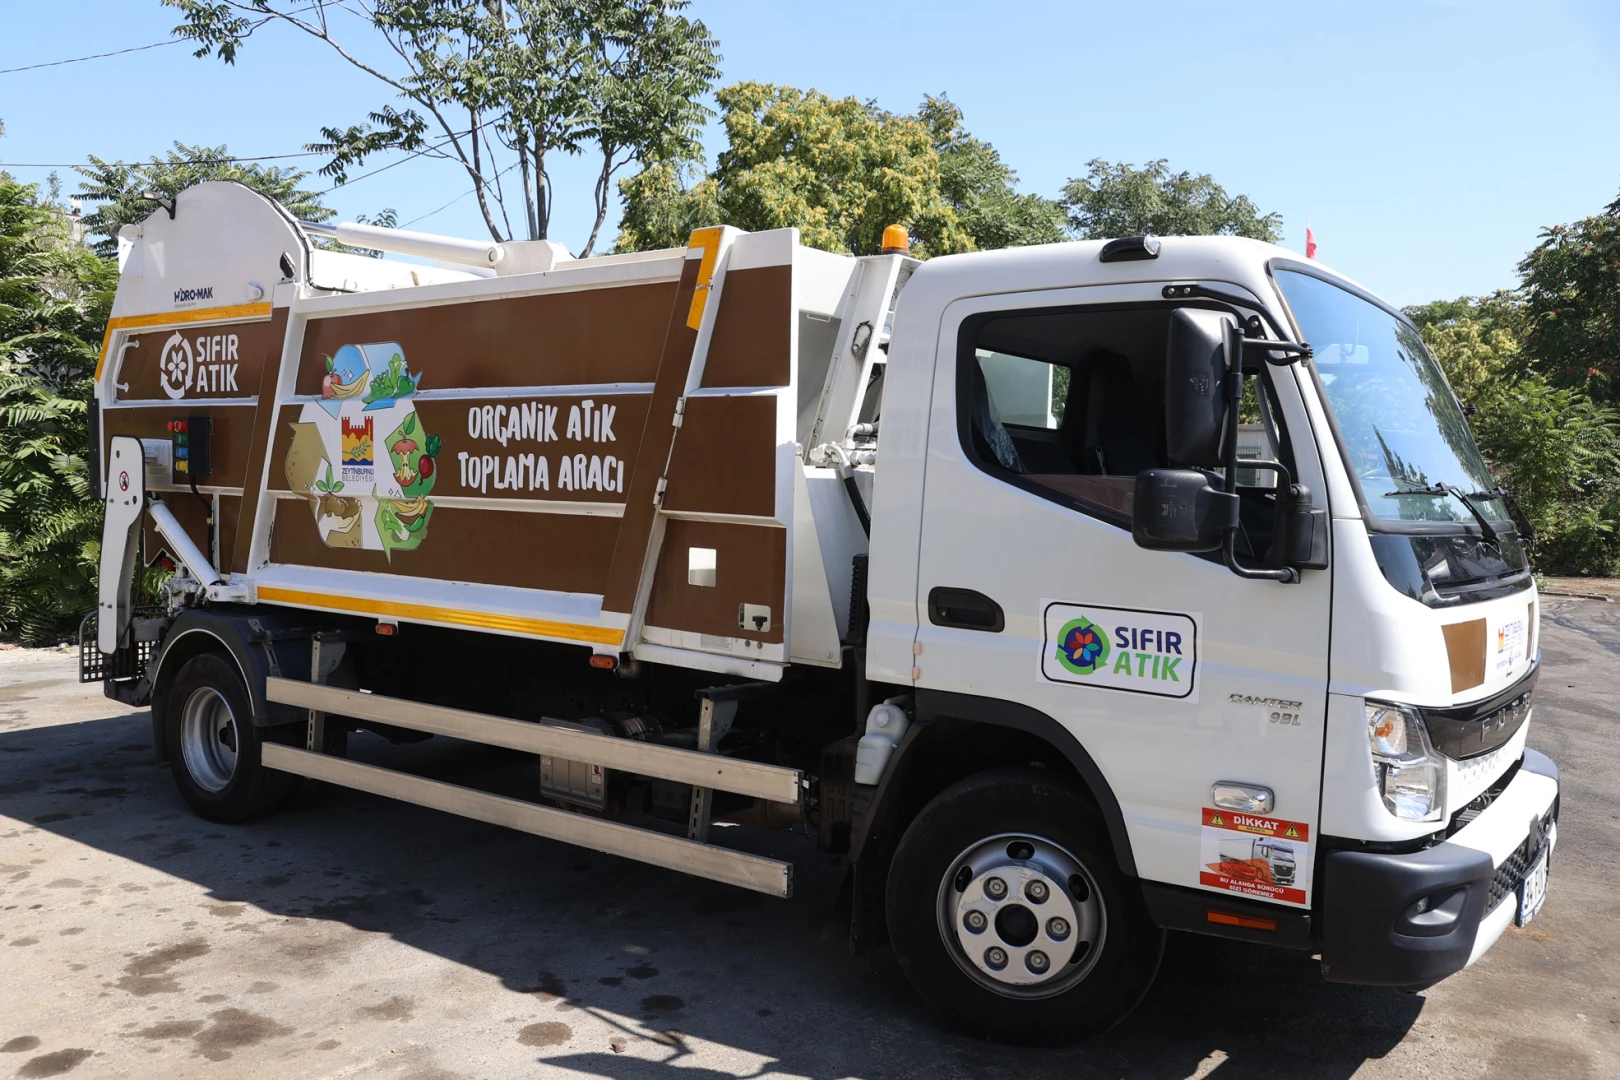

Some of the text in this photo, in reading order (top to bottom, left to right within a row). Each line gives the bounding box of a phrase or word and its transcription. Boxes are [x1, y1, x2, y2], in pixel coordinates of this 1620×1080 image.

[196, 334, 239, 362] SIFIR
[196, 363, 239, 392] ATIK
[566, 399, 616, 442] ATIK
[457, 451, 624, 494] TOPLAMA ARACI
[1115, 626, 1183, 655] SIFIR
[1114, 652, 1182, 682] ATIK
[1228, 693, 1303, 711] CANTER
[1234, 816, 1278, 830] DİKKAT
[1230, 879, 1256, 889] ALANDA
